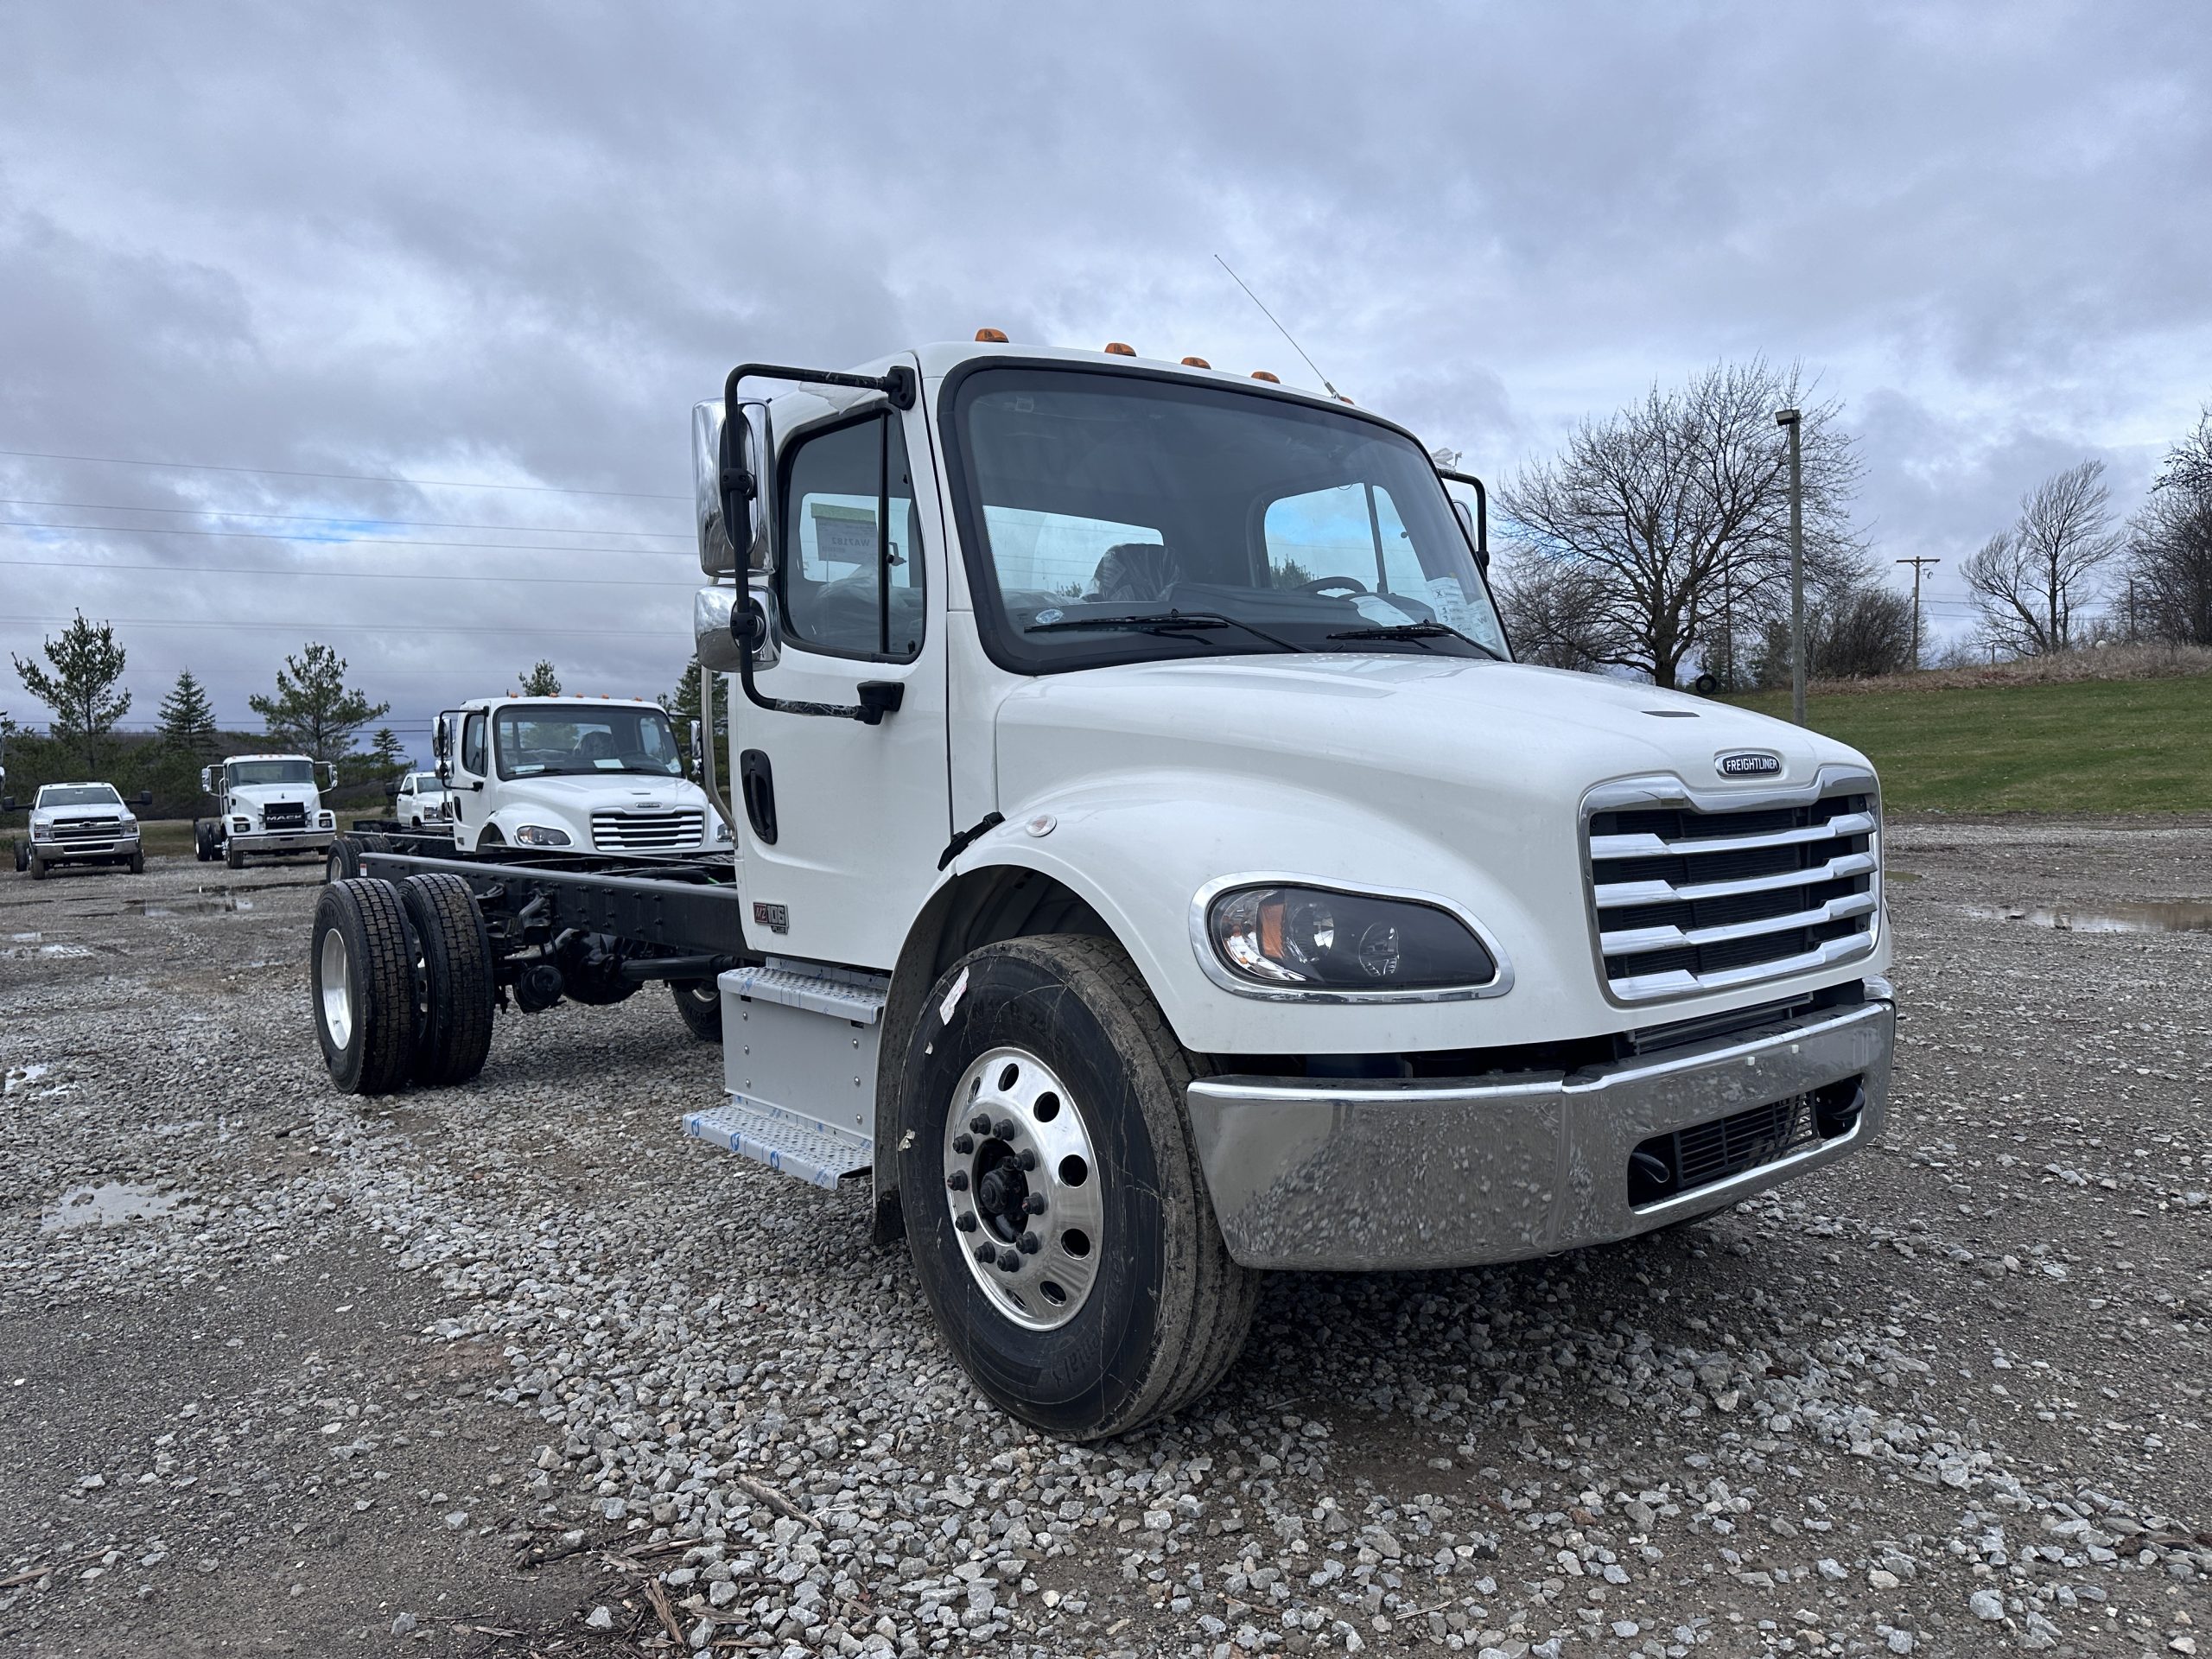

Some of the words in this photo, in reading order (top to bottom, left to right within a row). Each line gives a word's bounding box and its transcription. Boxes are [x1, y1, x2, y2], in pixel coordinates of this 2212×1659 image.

[1726, 758, 1777, 772] FREIGHTLINER
[755, 906, 766, 919] M2
[767, 906, 785, 925] 106
